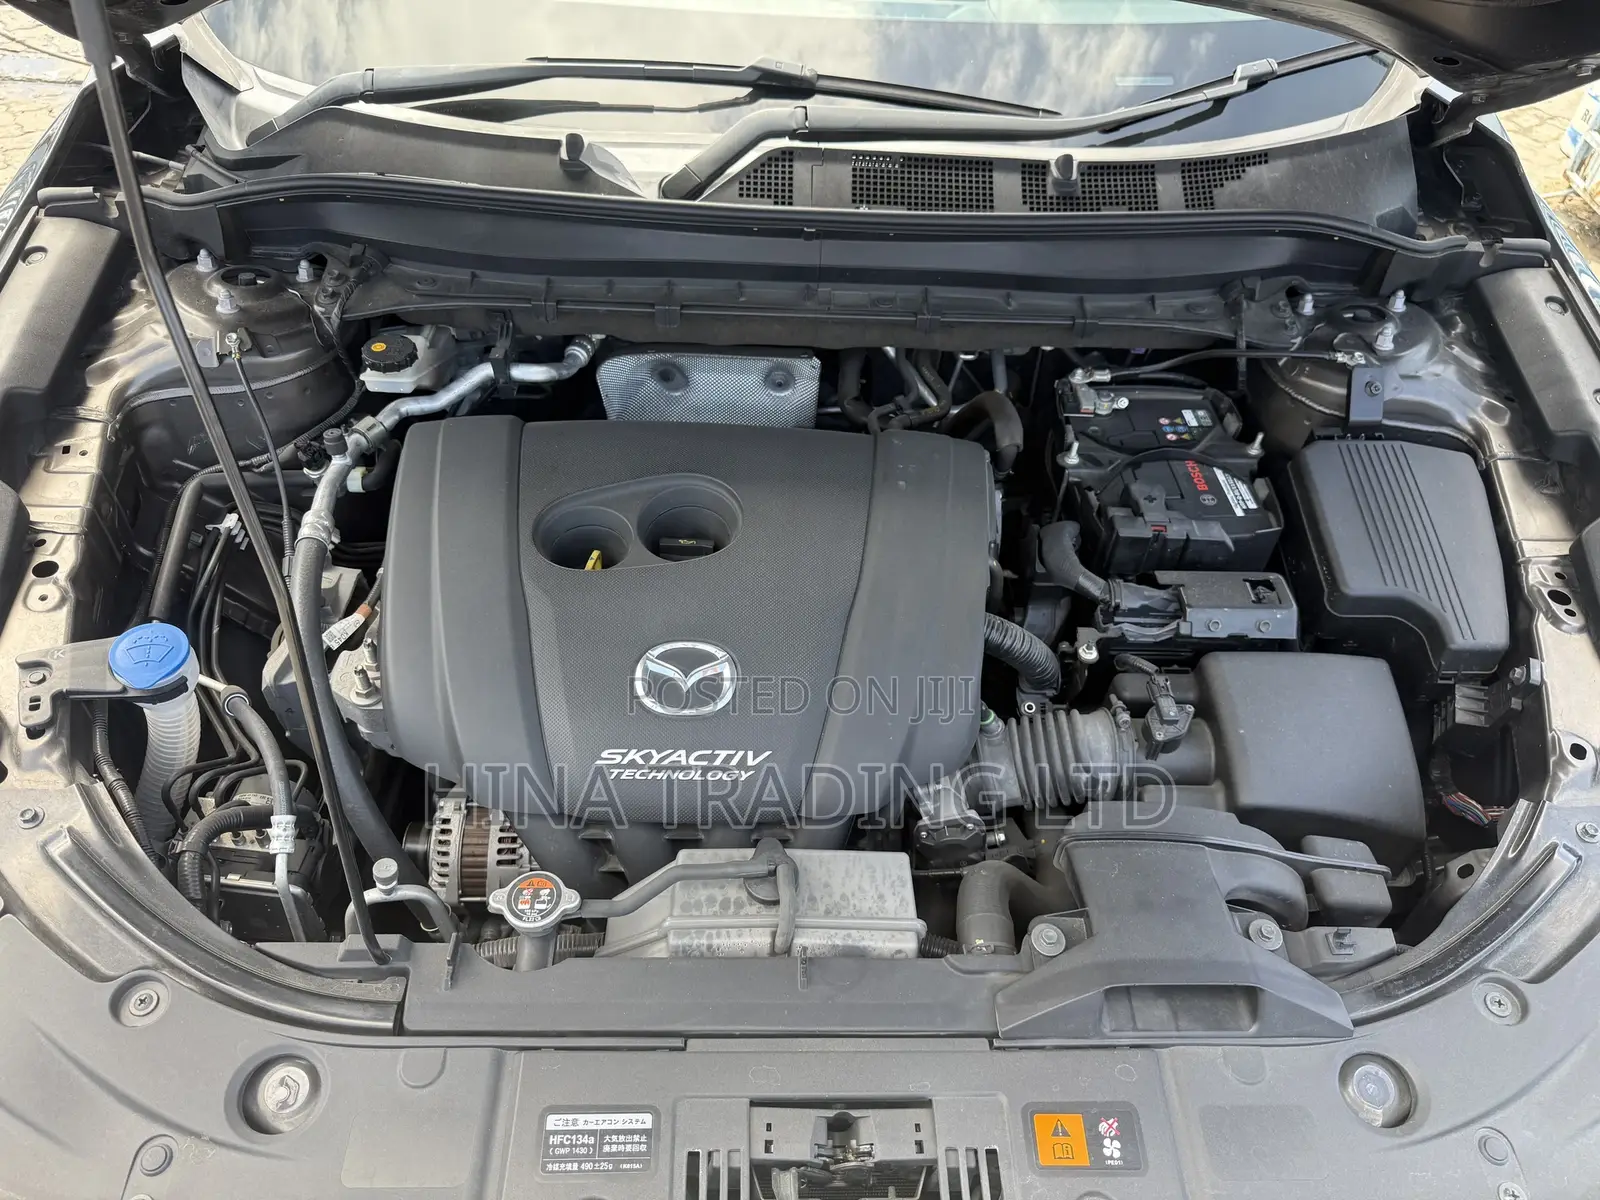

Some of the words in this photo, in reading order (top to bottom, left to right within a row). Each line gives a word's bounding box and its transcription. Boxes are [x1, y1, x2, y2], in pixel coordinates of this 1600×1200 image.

[1184, 460, 1209, 491] BOSCH
[594, 749, 772, 766] SKYACTIV
[608, 769, 755, 781] TECHNOLOGY
[553, 1117, 580, 1128] ご注意
[582, 1118, 620, 1126] カーエアコン
[621, 1118, 647, 1126] システム
[549, 1134, 595, 1145] HFC134a
[603, 1134, 648, 1143] 大気放出禁止
